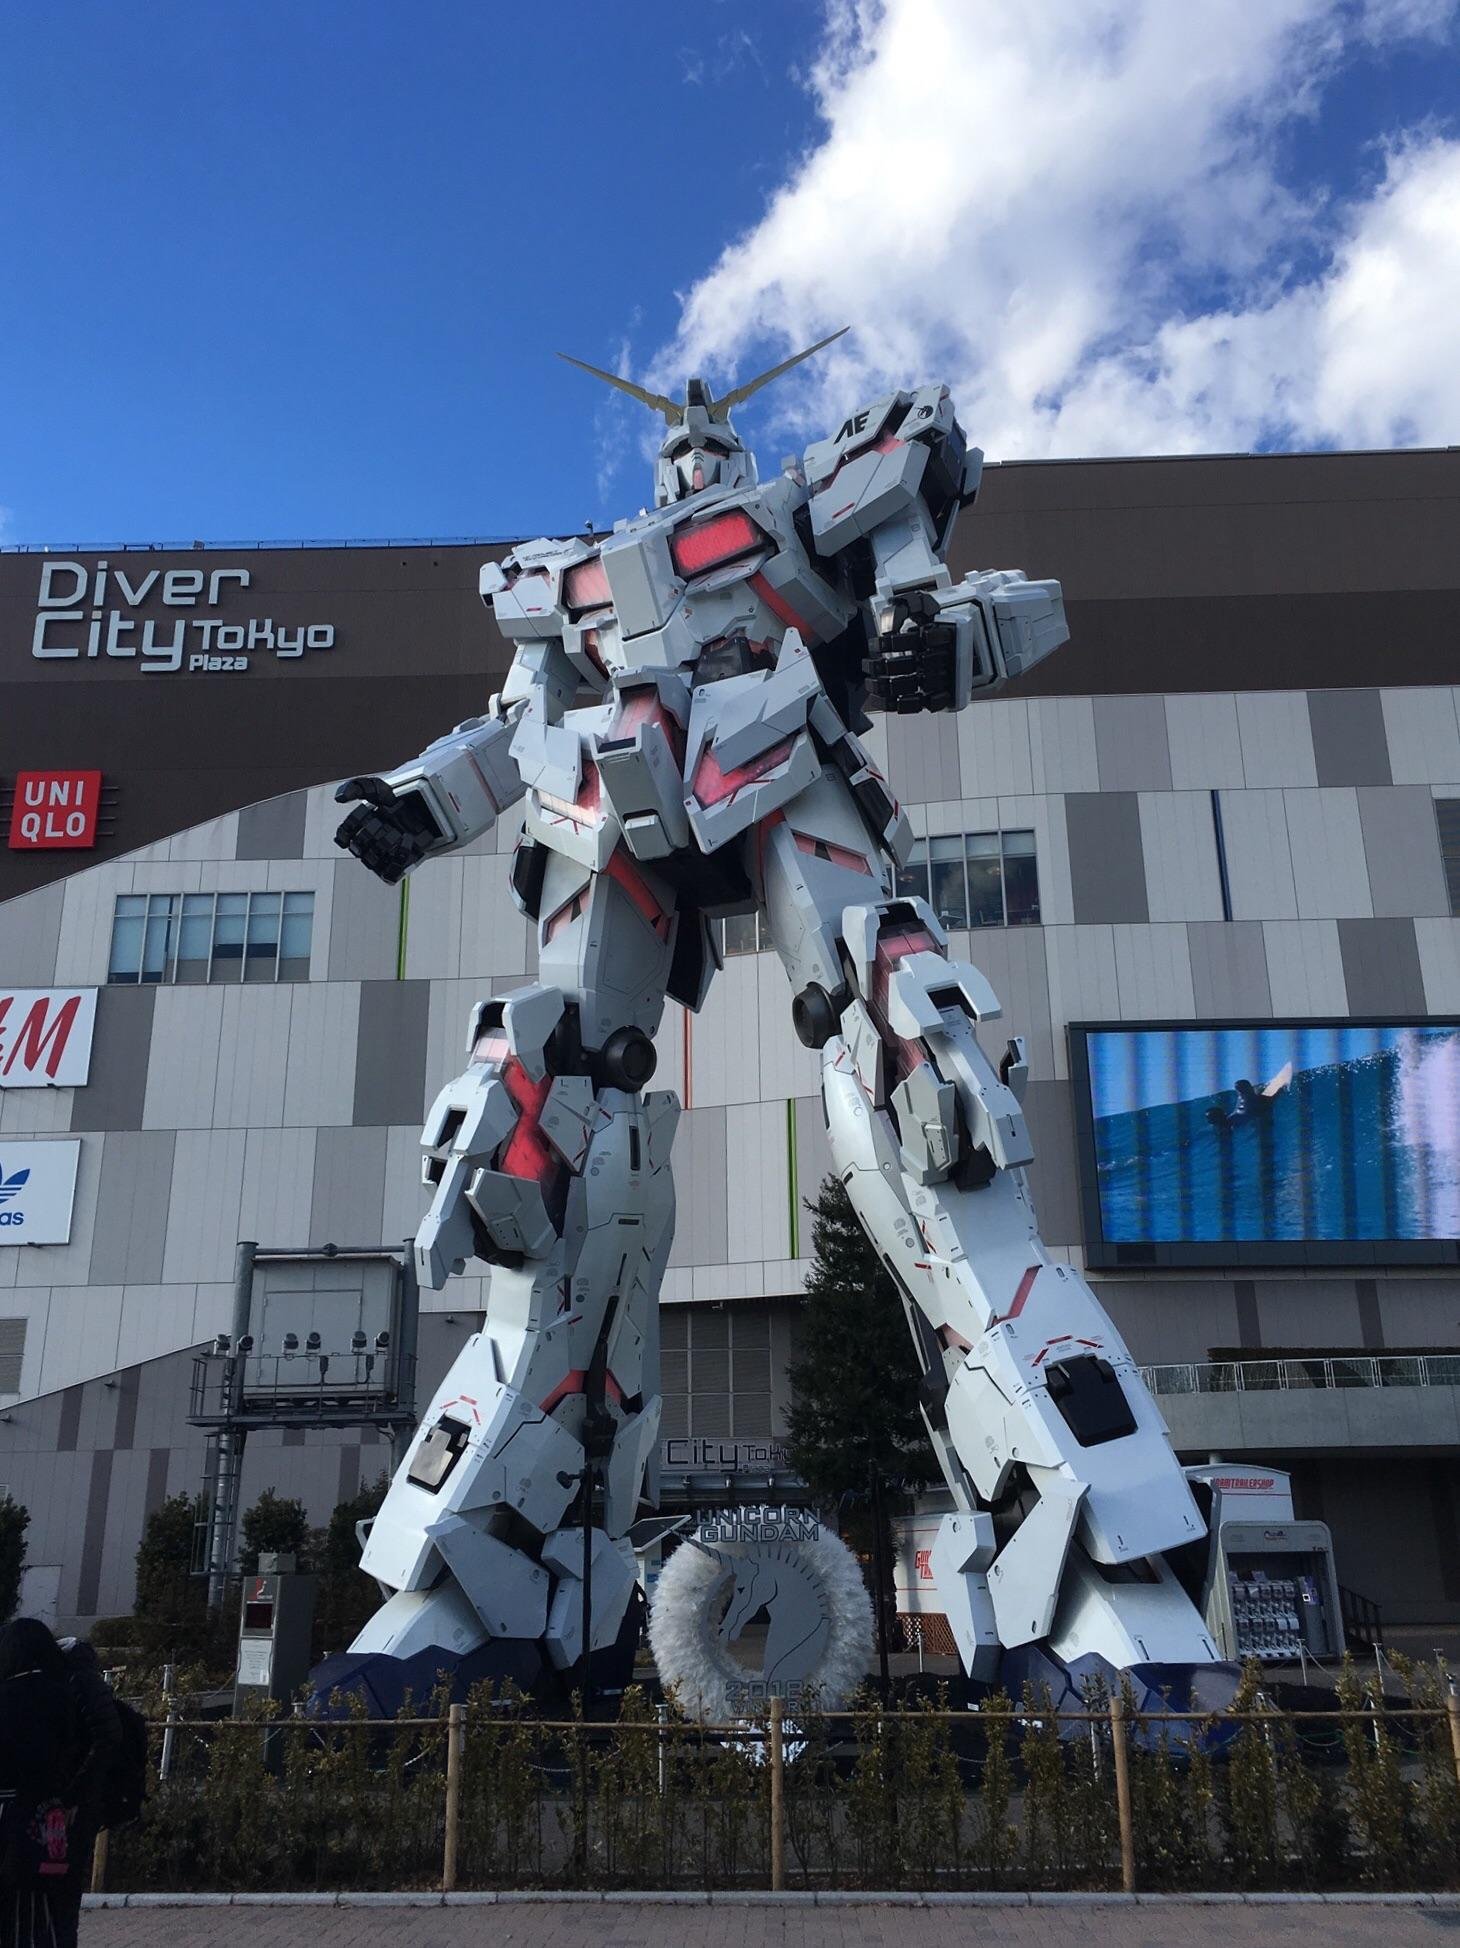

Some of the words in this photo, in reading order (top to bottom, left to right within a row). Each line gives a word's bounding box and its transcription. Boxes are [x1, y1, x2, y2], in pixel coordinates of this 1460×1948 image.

[37, 560, 250, 608] Diver
[31, 610, 186, 672] City
[192, 618, 335, 658] Tokyo
[189, 654, 248, 671] Plaza
[25, 780, 84, 806] UNI
[21, 812, 86, 842] QLO
[667, 1438, 738, 1473] City
[696, 1507, 821, 1526] UNICORN
[700, 1523, 820, 1543] GUNDAM
